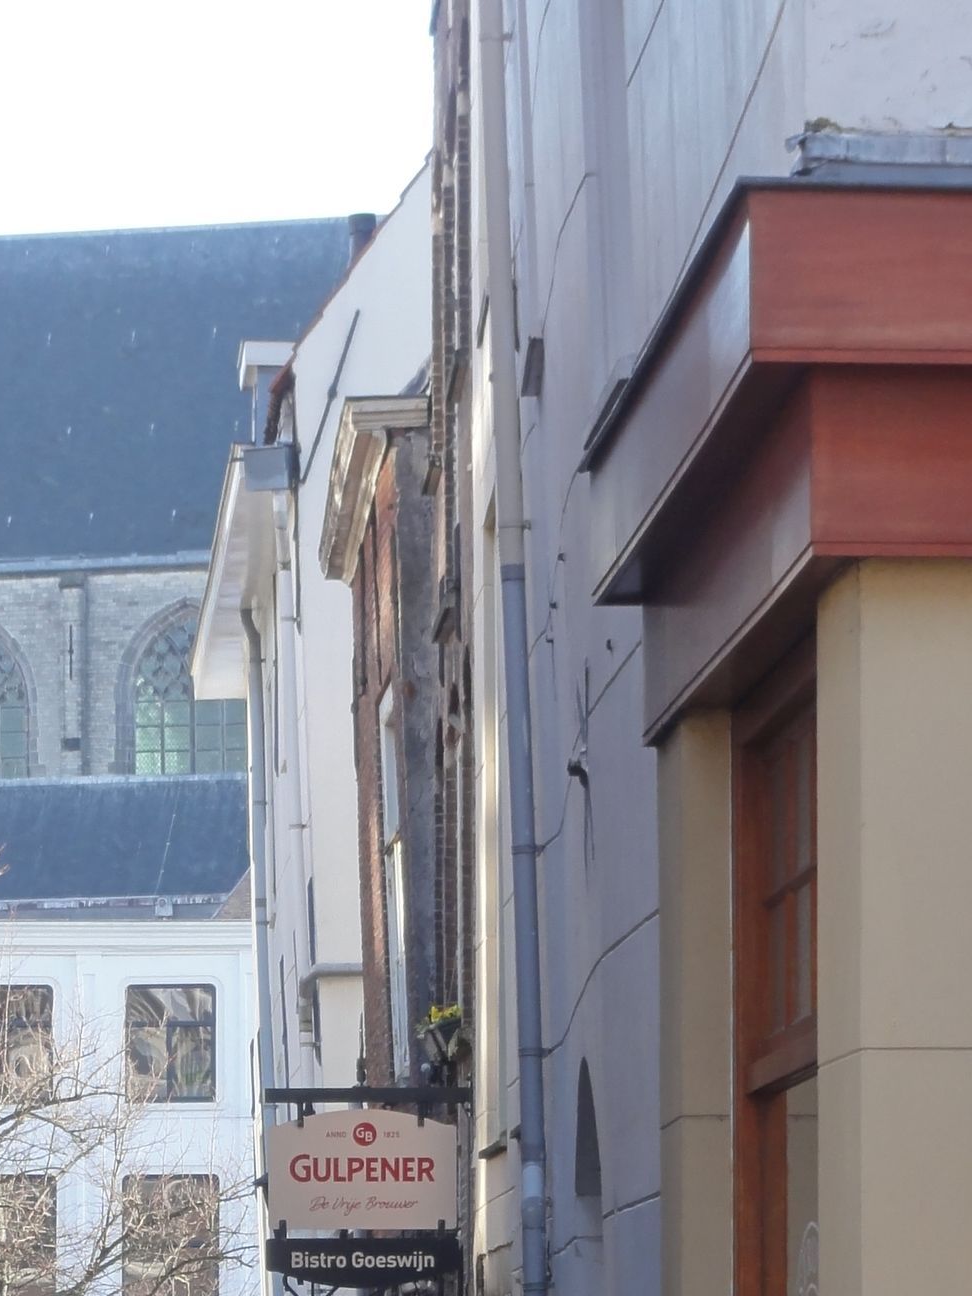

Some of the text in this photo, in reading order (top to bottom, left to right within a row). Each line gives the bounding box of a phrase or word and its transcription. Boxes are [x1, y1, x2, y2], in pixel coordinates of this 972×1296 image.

[289, 1153, 435, 1182] GULPENER
[309, 1196, 330, 1212] De
[364, 1196, 418, 1211] Brouwer
[291, 1251, 435, 1272] Bistro Goeswijn
